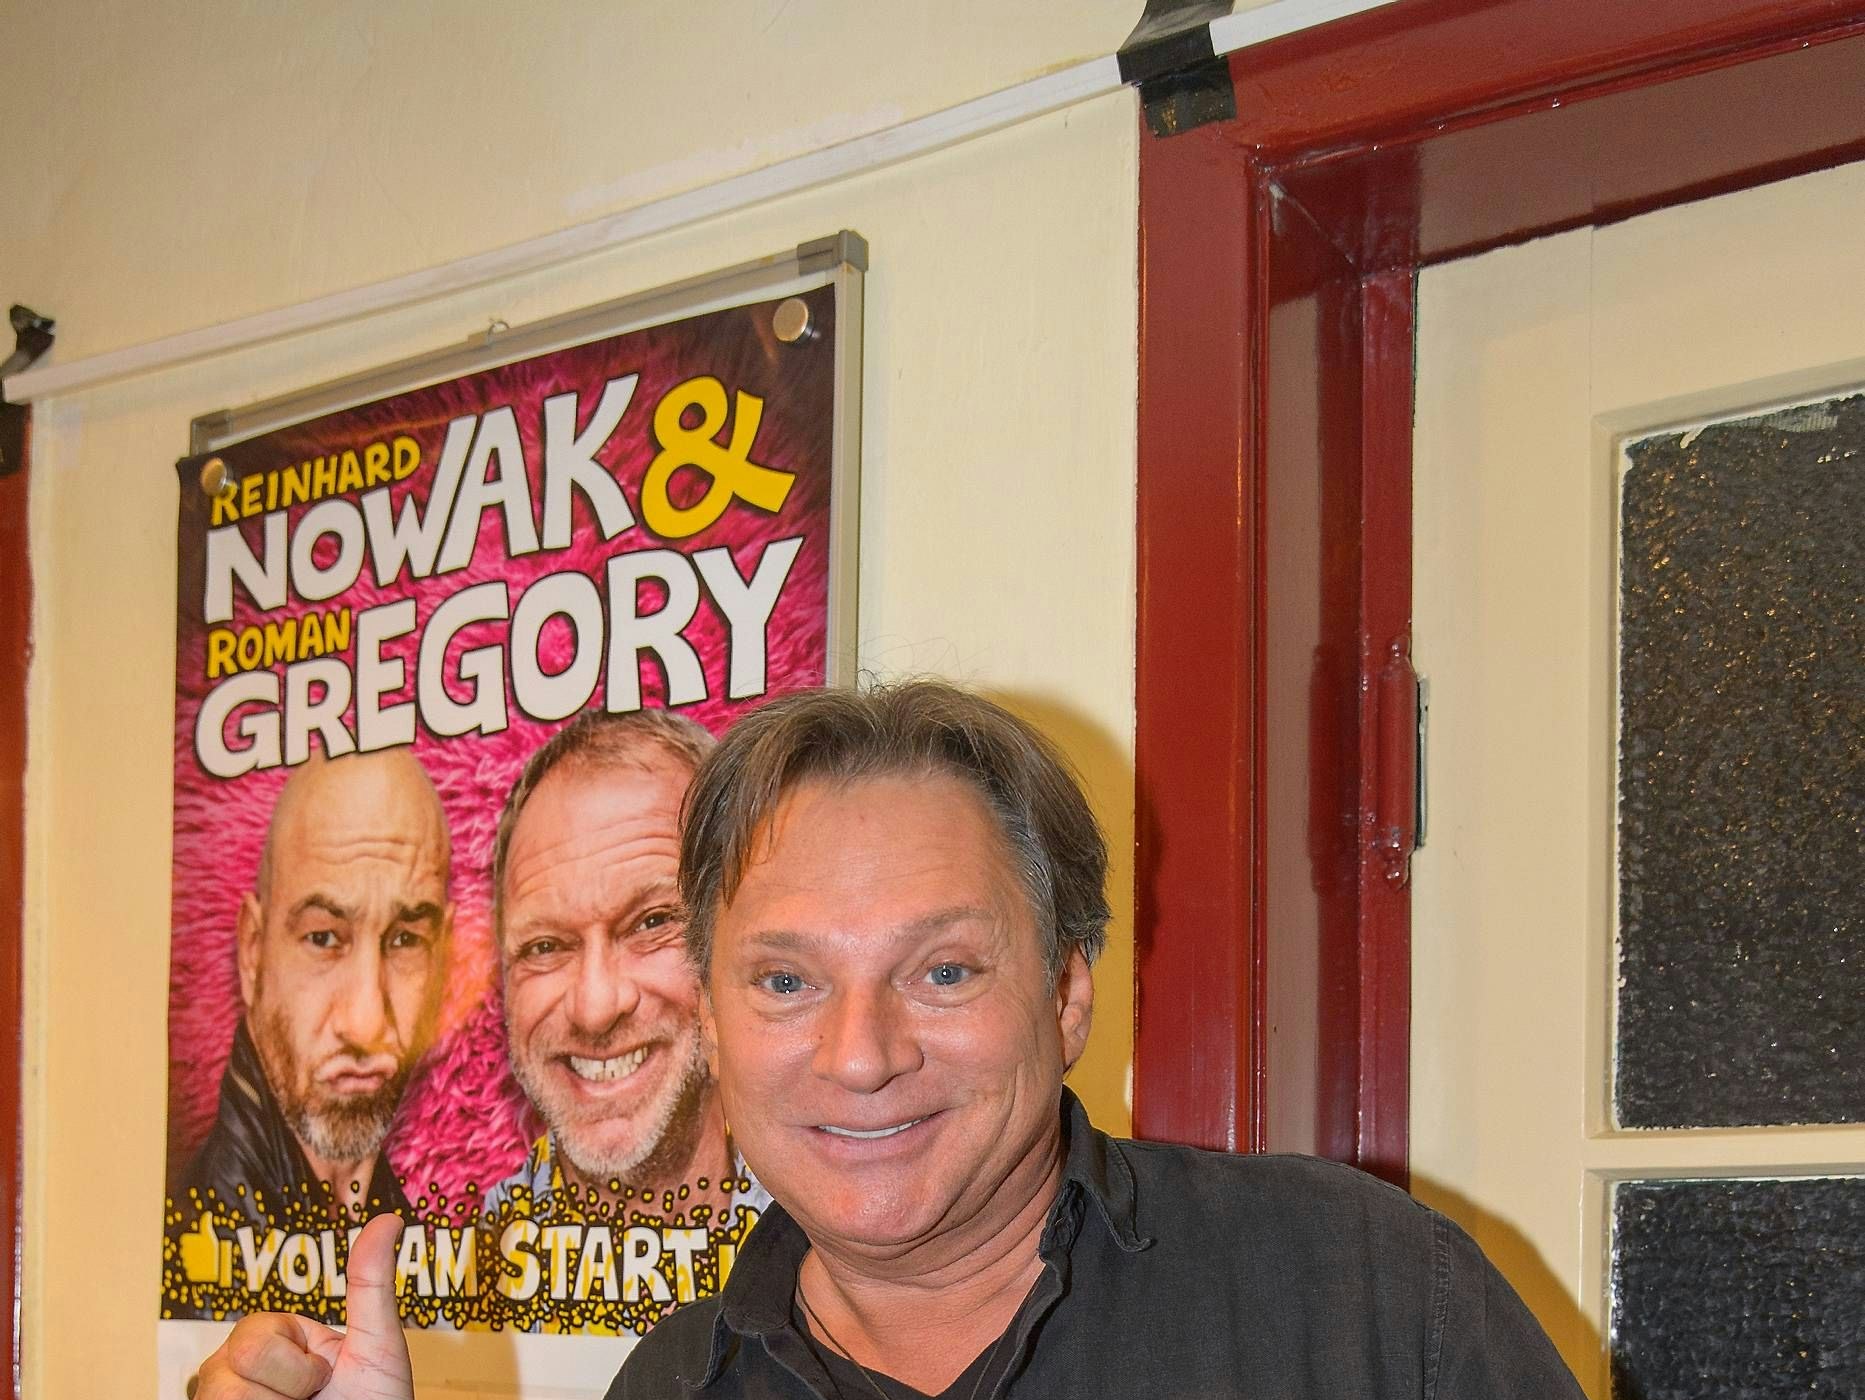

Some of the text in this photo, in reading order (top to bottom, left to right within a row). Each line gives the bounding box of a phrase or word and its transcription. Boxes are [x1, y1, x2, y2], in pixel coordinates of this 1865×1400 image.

[203, 372, 797, 625] NOWAK &
[210, 437, 421, 527] REINHARD
[196, 536, 804, 777] GREGORY
[206, 607, 352, 679] ROMAN
[236, 1219, 709, 1304] VOL AM START
